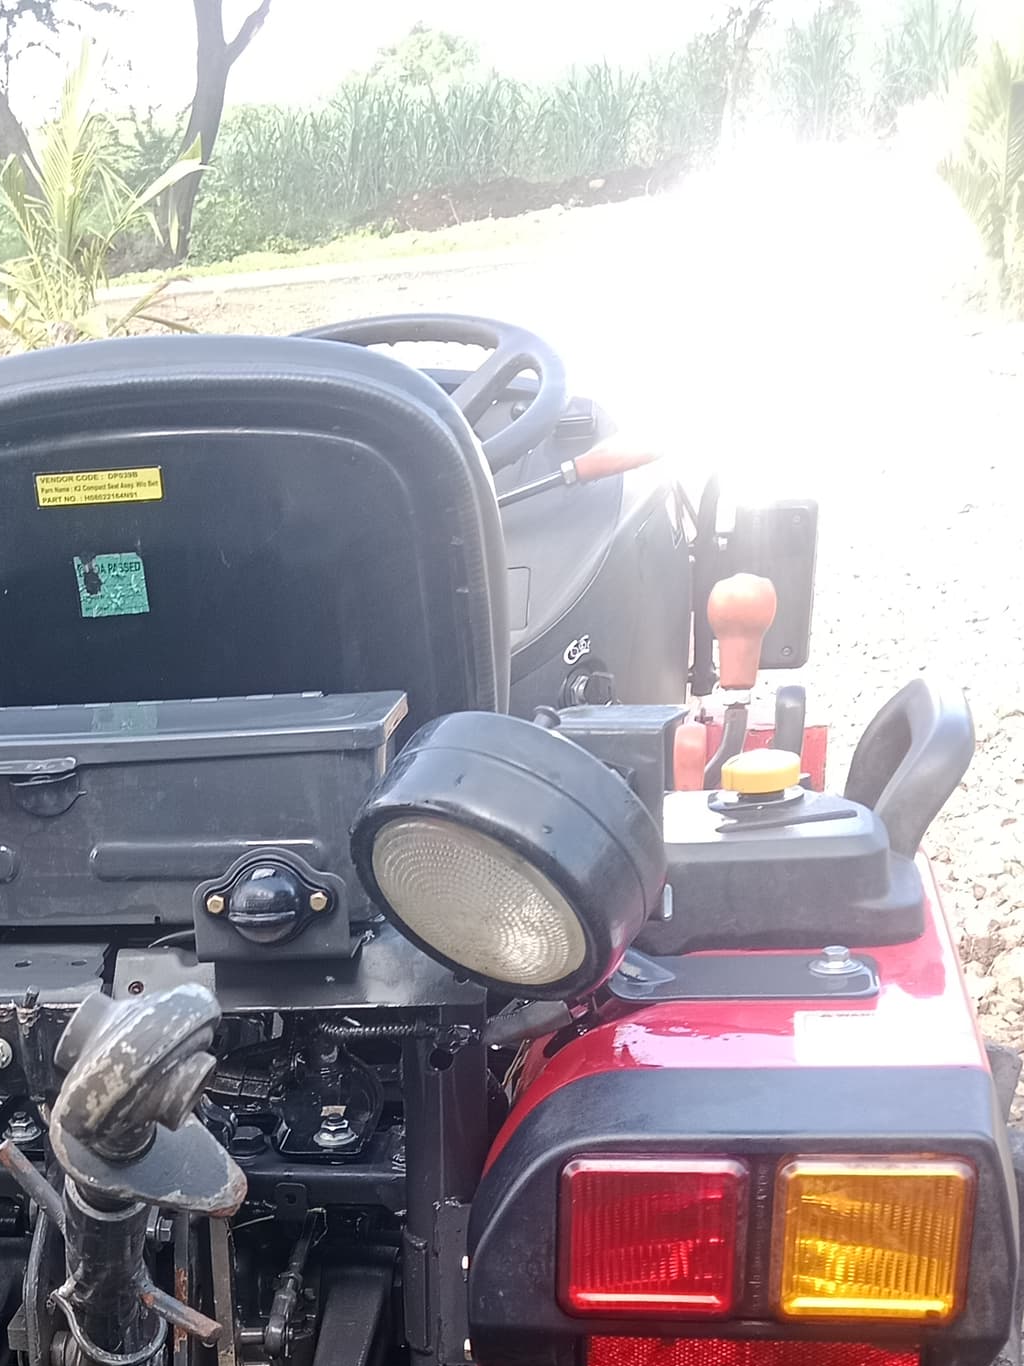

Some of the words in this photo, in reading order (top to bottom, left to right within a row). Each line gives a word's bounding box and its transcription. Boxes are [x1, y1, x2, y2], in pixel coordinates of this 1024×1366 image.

[39, 475, 74, 483] VENDOR
[42, 496, 62, 504] PART
[107, 561, 141, 574] PASSED
